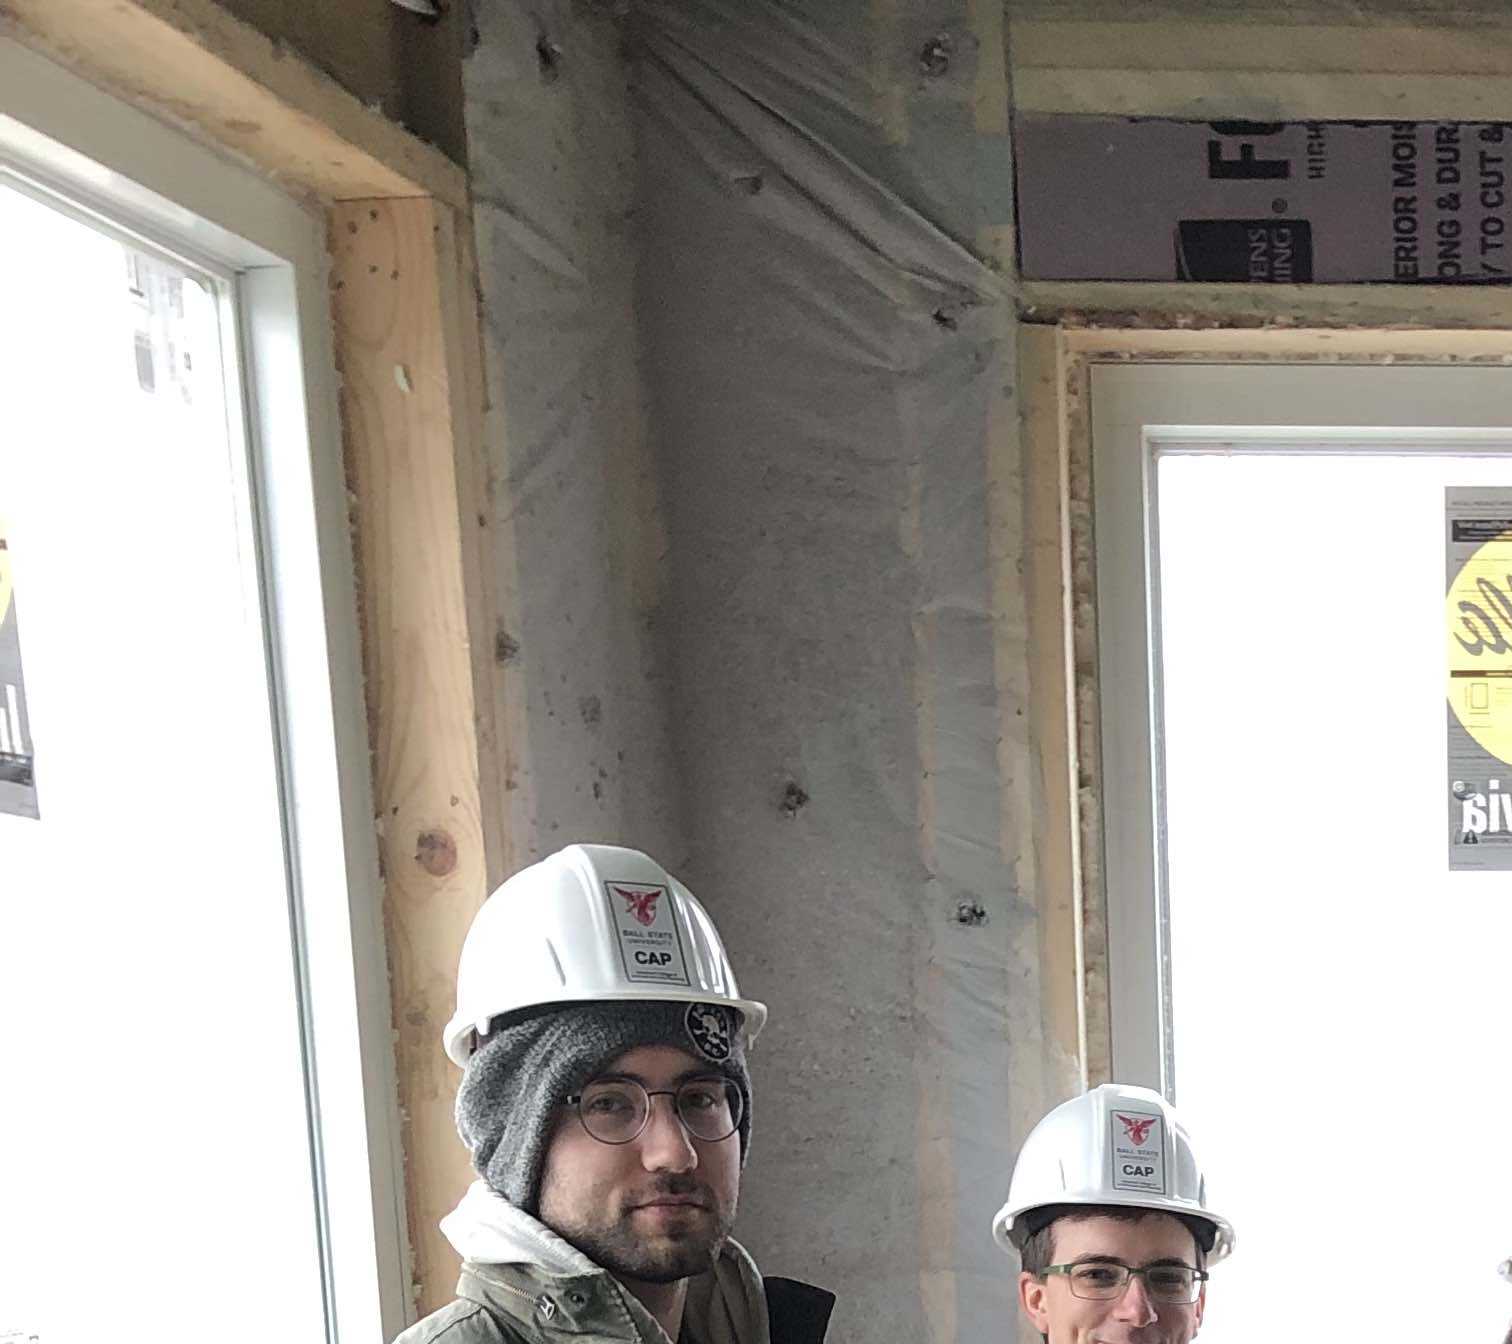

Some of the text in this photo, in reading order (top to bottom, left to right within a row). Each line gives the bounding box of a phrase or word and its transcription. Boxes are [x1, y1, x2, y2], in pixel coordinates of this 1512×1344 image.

[1478, 125, 1502, 145] &
[1478, 151, 1504, 209] CUT
[1436, 191, 1460, 212] &
[1480, 217, 1505, 256] TO
[1248, 229, 1267, 282] ENS
[634, 950, 672, 966] CAP
[1122, 1164, 1155, 1177] CAP
